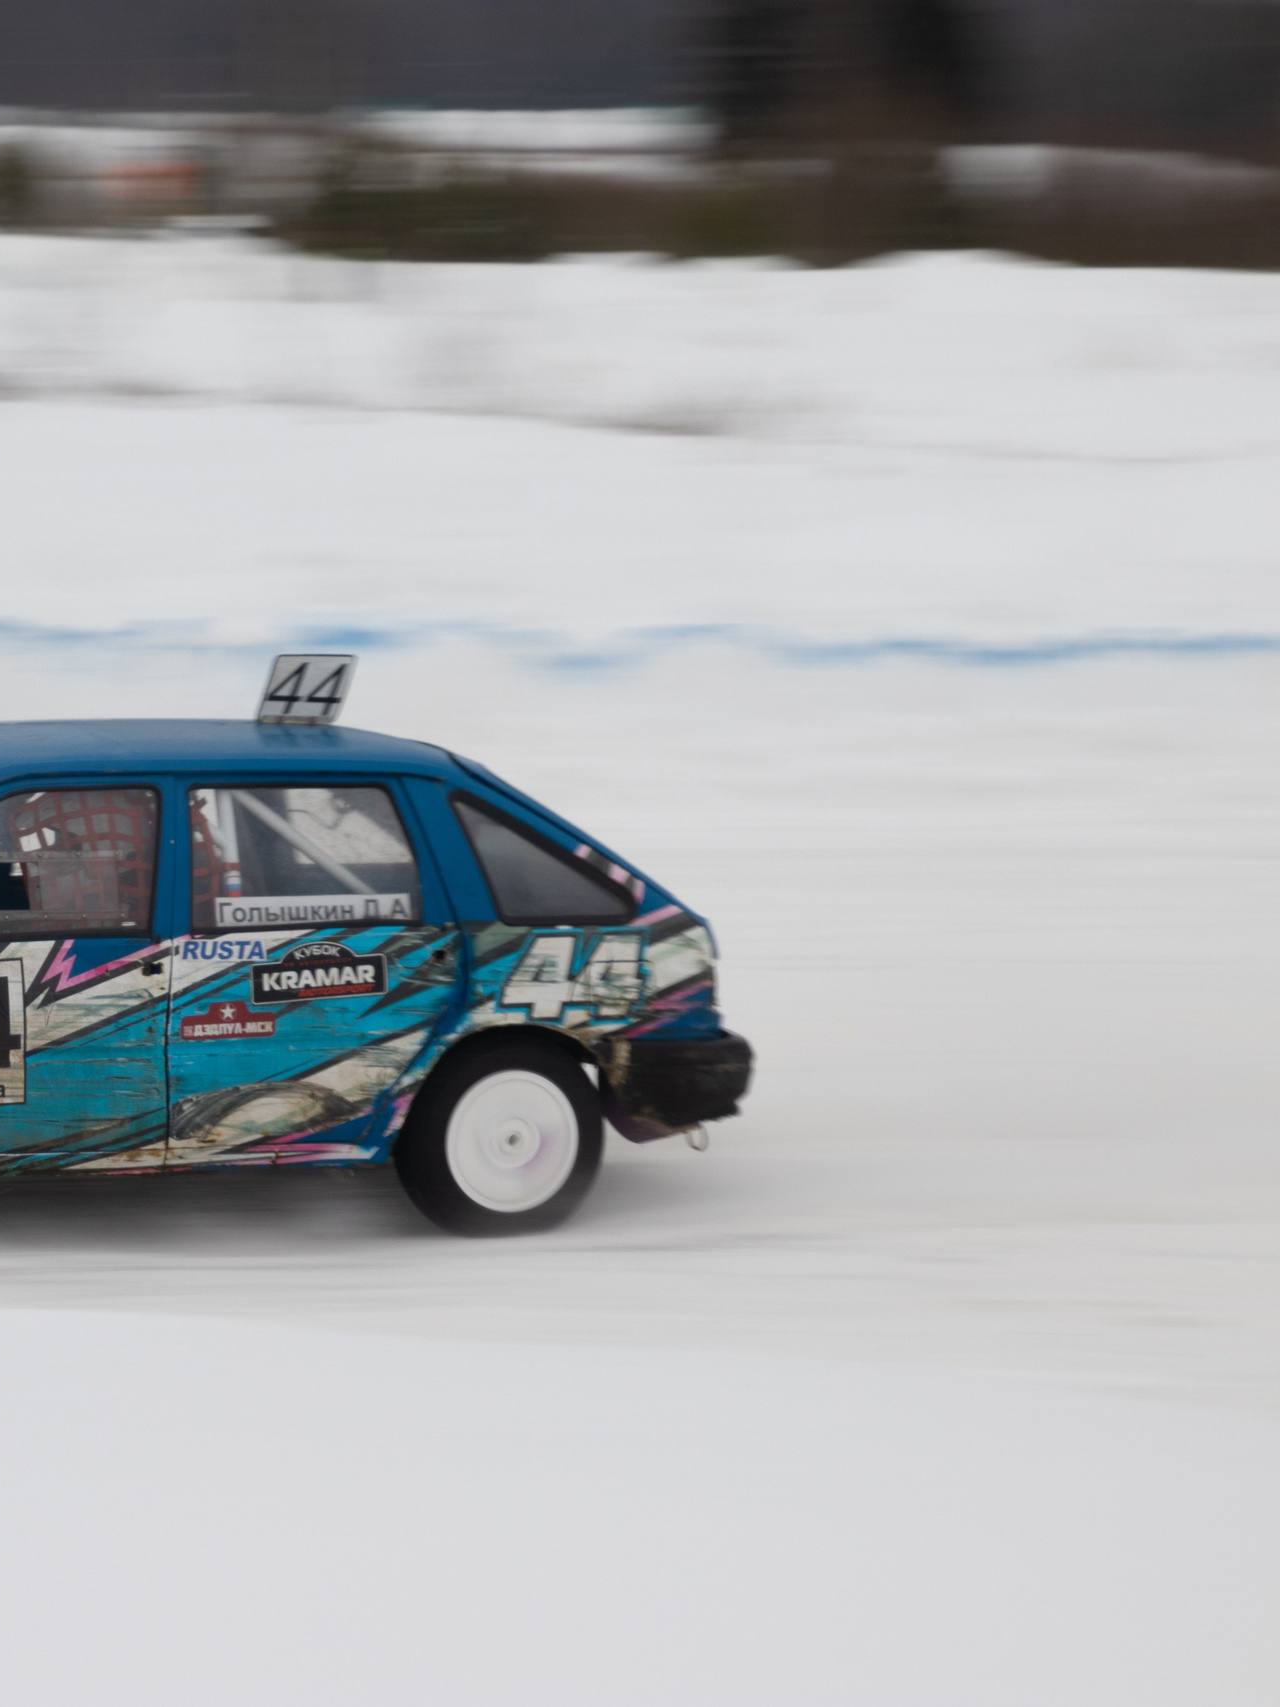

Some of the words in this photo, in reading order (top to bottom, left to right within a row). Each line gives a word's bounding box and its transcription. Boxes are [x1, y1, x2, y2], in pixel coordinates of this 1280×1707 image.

[266, 662, 349, 716] 44
[218, 902, 355, 923] Голышкин
[182, 940, 265, 960] RUSTA
[293, 944, 342, 960] КУБОК
[261, 964, 376, 992] KRAMAR
[499, 933, 646, 1021] 44
